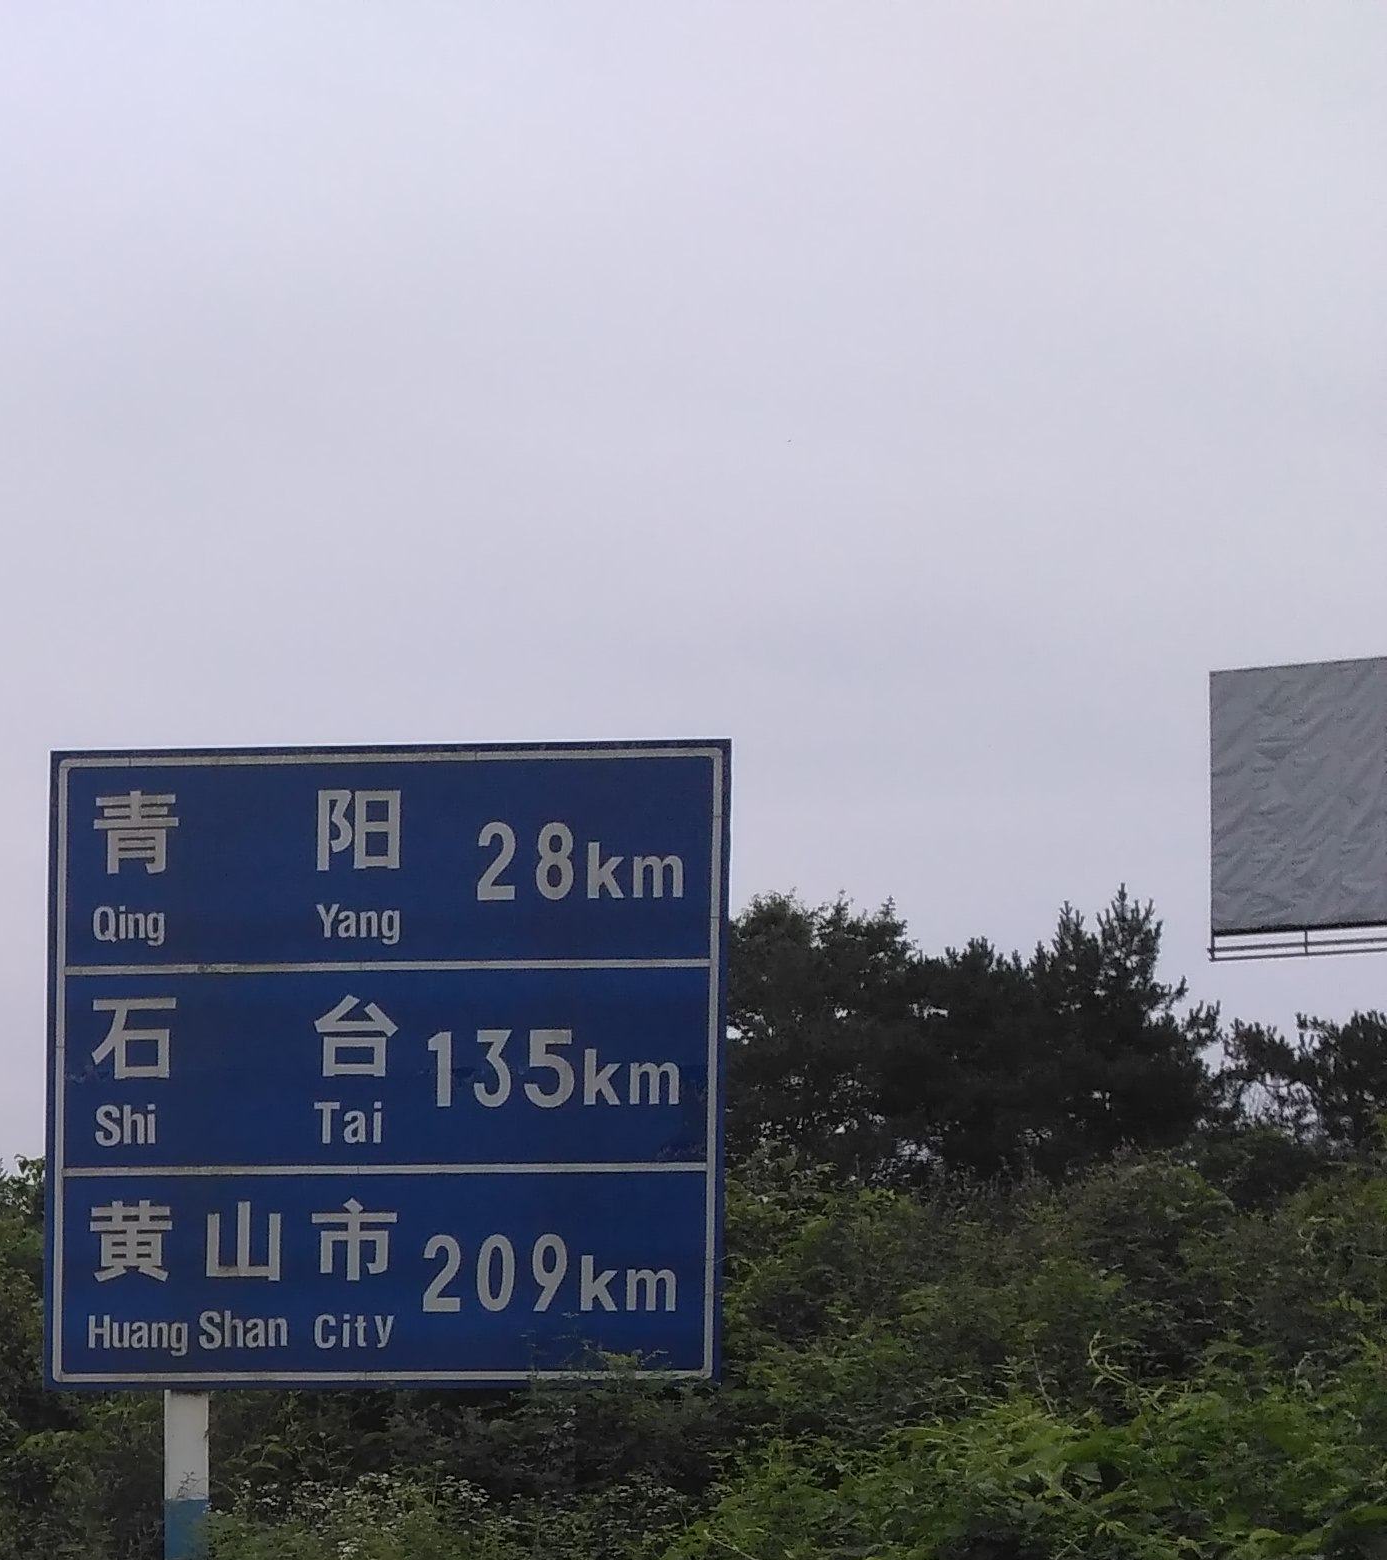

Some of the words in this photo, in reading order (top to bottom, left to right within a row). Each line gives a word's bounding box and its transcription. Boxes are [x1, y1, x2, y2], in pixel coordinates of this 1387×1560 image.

[476, 822, 685, 901] 28km
[93, 904, 166, 946] Qing
[316, 902, 401, 944] Yang
[427, 1028, 680, 1108] 135km
[94, 1104, 157, 1145] Shi
[313, 1101, 383, 1143] Tai
[88, 1197, 398, 1282] 黄山市
[422, 1232, 677, 1313] 209km
[87, 1314, 188, 1355] Huang
[198, 1310, 288, 1348] Shan
[314, 1311, 394, 1348] City
